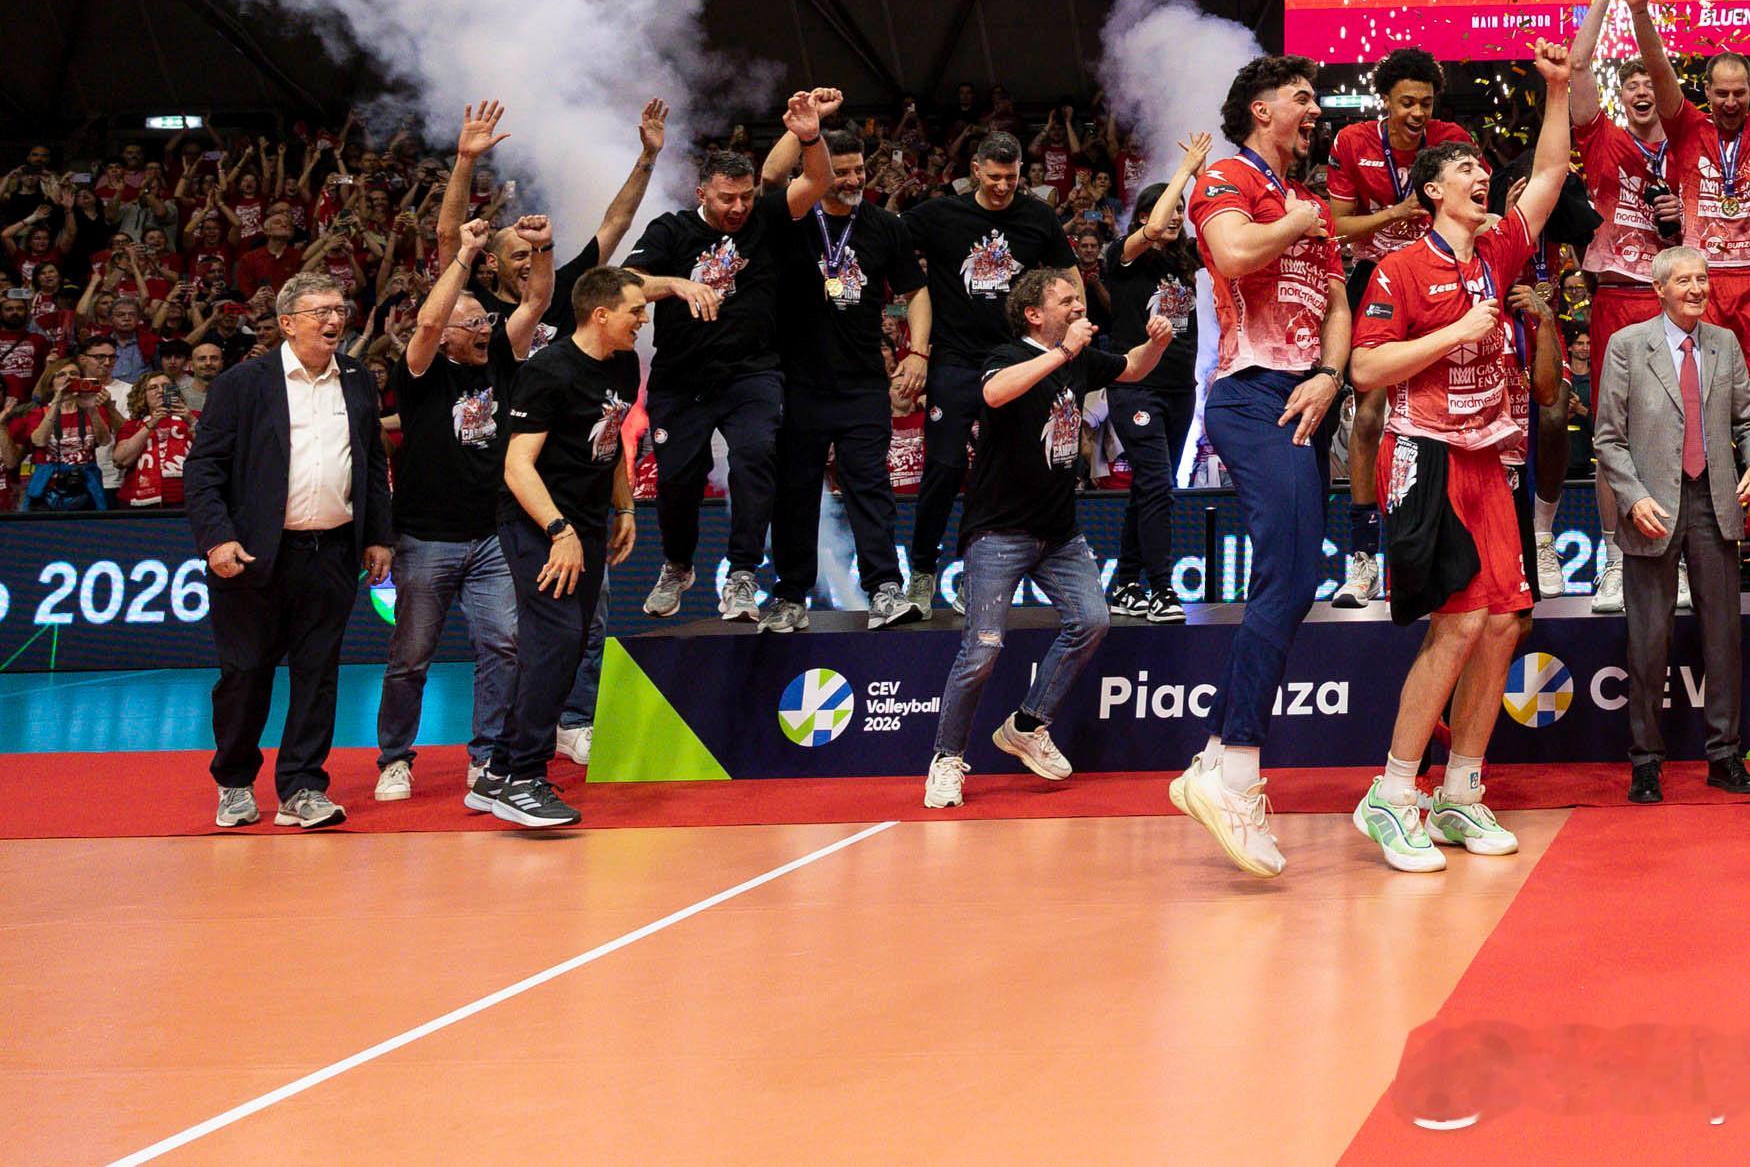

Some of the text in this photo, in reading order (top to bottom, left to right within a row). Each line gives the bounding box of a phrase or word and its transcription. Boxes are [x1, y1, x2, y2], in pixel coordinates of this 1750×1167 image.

[1472, 16, 1498, 28] MAIN
[1503, 15, 1551, 28] SPONSOR
[1358, 159, 1385, 168] Zeus
[1429, 283, 1457, 295] Zeus
[1476, 362, 1494, 375] GAS
[34, 559, 210, 625] 2026
[867, 681, 900, 696] CEV
[1099, 670, 1349, 719] Piacza
[866, 697, 940, 716] Volleyball
[863, 716, 901, 732] 2026
